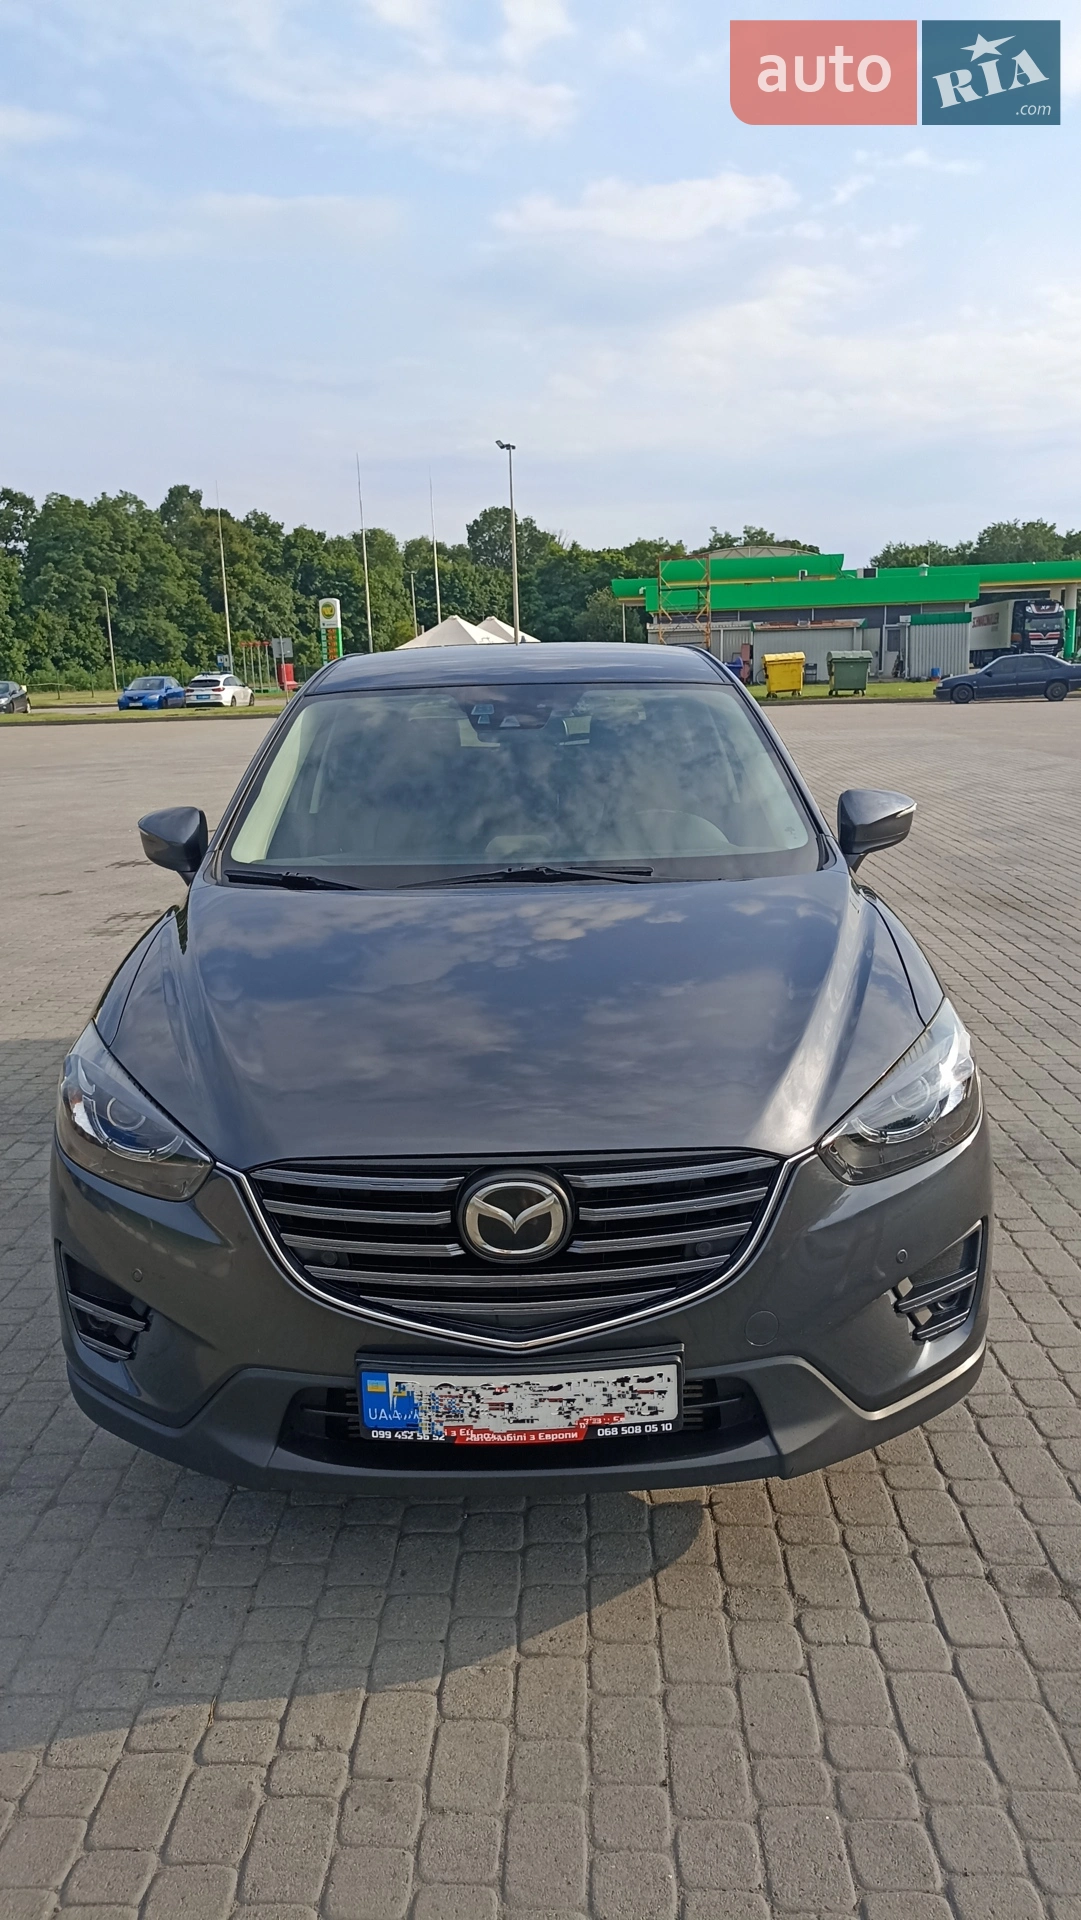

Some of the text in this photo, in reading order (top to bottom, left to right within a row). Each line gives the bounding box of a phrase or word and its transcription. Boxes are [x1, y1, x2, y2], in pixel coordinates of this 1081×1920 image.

[597, 1422, 672, 1436] 068 508 05 10
[371, 1430, 391, 1439] 099
[394, 1430, 414, 1440] 452
[538, 1432, 578, 1441] Європи
